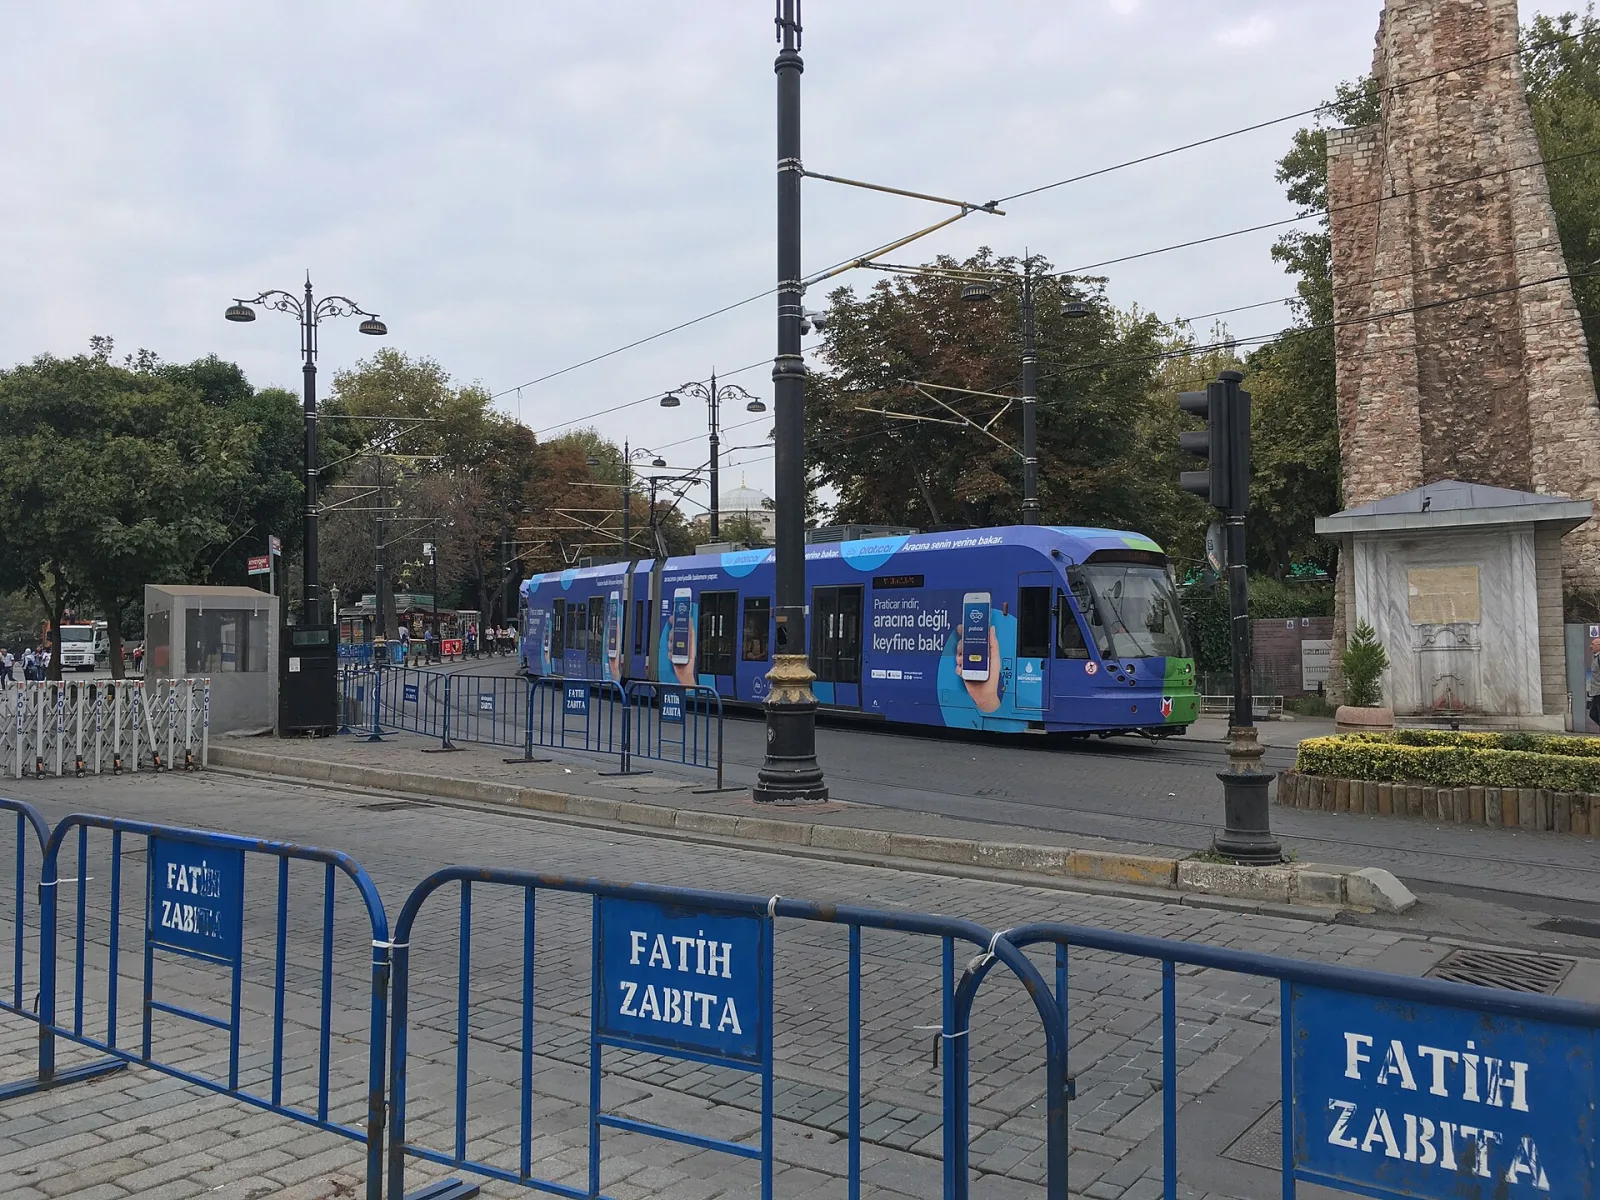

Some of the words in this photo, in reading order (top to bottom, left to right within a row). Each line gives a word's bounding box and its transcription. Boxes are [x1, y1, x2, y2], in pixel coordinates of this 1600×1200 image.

[901, 542, 930, 552] Aracına
[930, 539, 951, 550] senin
[952, 537, 977, 549] yerine
[978, 535, 1003, 545] bakar.
[873, 614, 915, 628] aracına
[917, 609, 951, 632] değil,
[874, 598, 901, 610] Praticar
[873, 633, 915, 654] keyfine
[918, 633, 944, 652] bak!
[629, 929, 732, 979] FATİH
[619, 981, 742, 1035] ZABITA
[1343, 1031, 1530, 1113] FATİH
[1327, 1097, 1551, 1192] ZABITA
